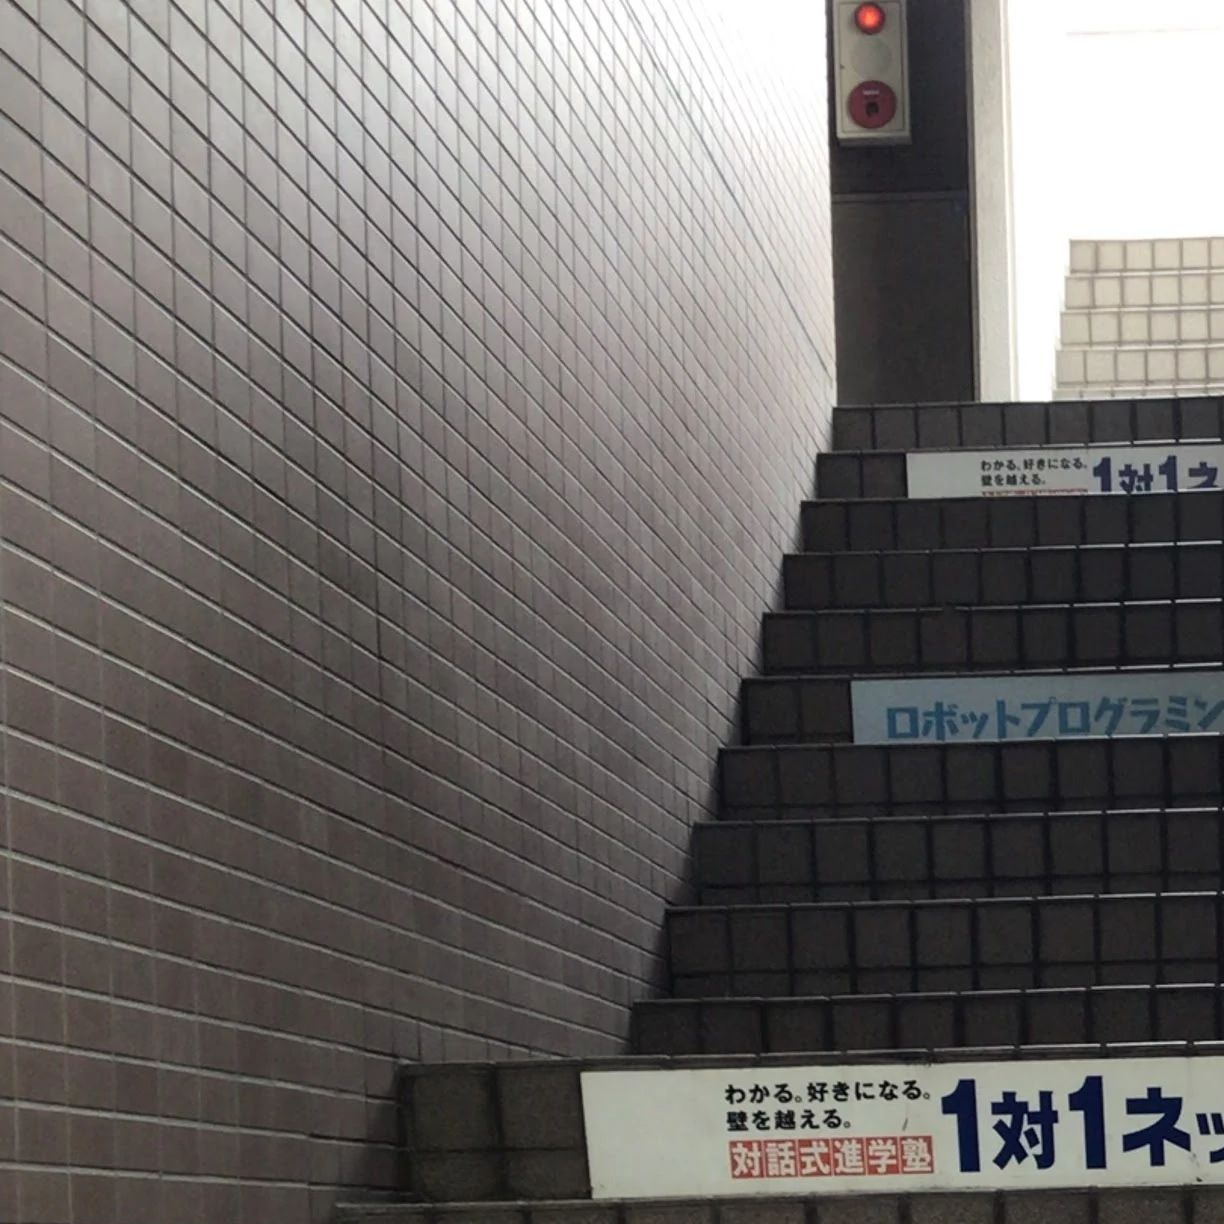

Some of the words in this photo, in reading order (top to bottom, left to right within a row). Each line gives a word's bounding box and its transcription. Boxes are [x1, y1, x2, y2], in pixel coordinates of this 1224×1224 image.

[725, 1080, 931, 1104] わかる。好きになる。
[726, 1109, 851, 1131] 壁を越える。
[731, 1138, 933, 1177] 対話式進学塾
